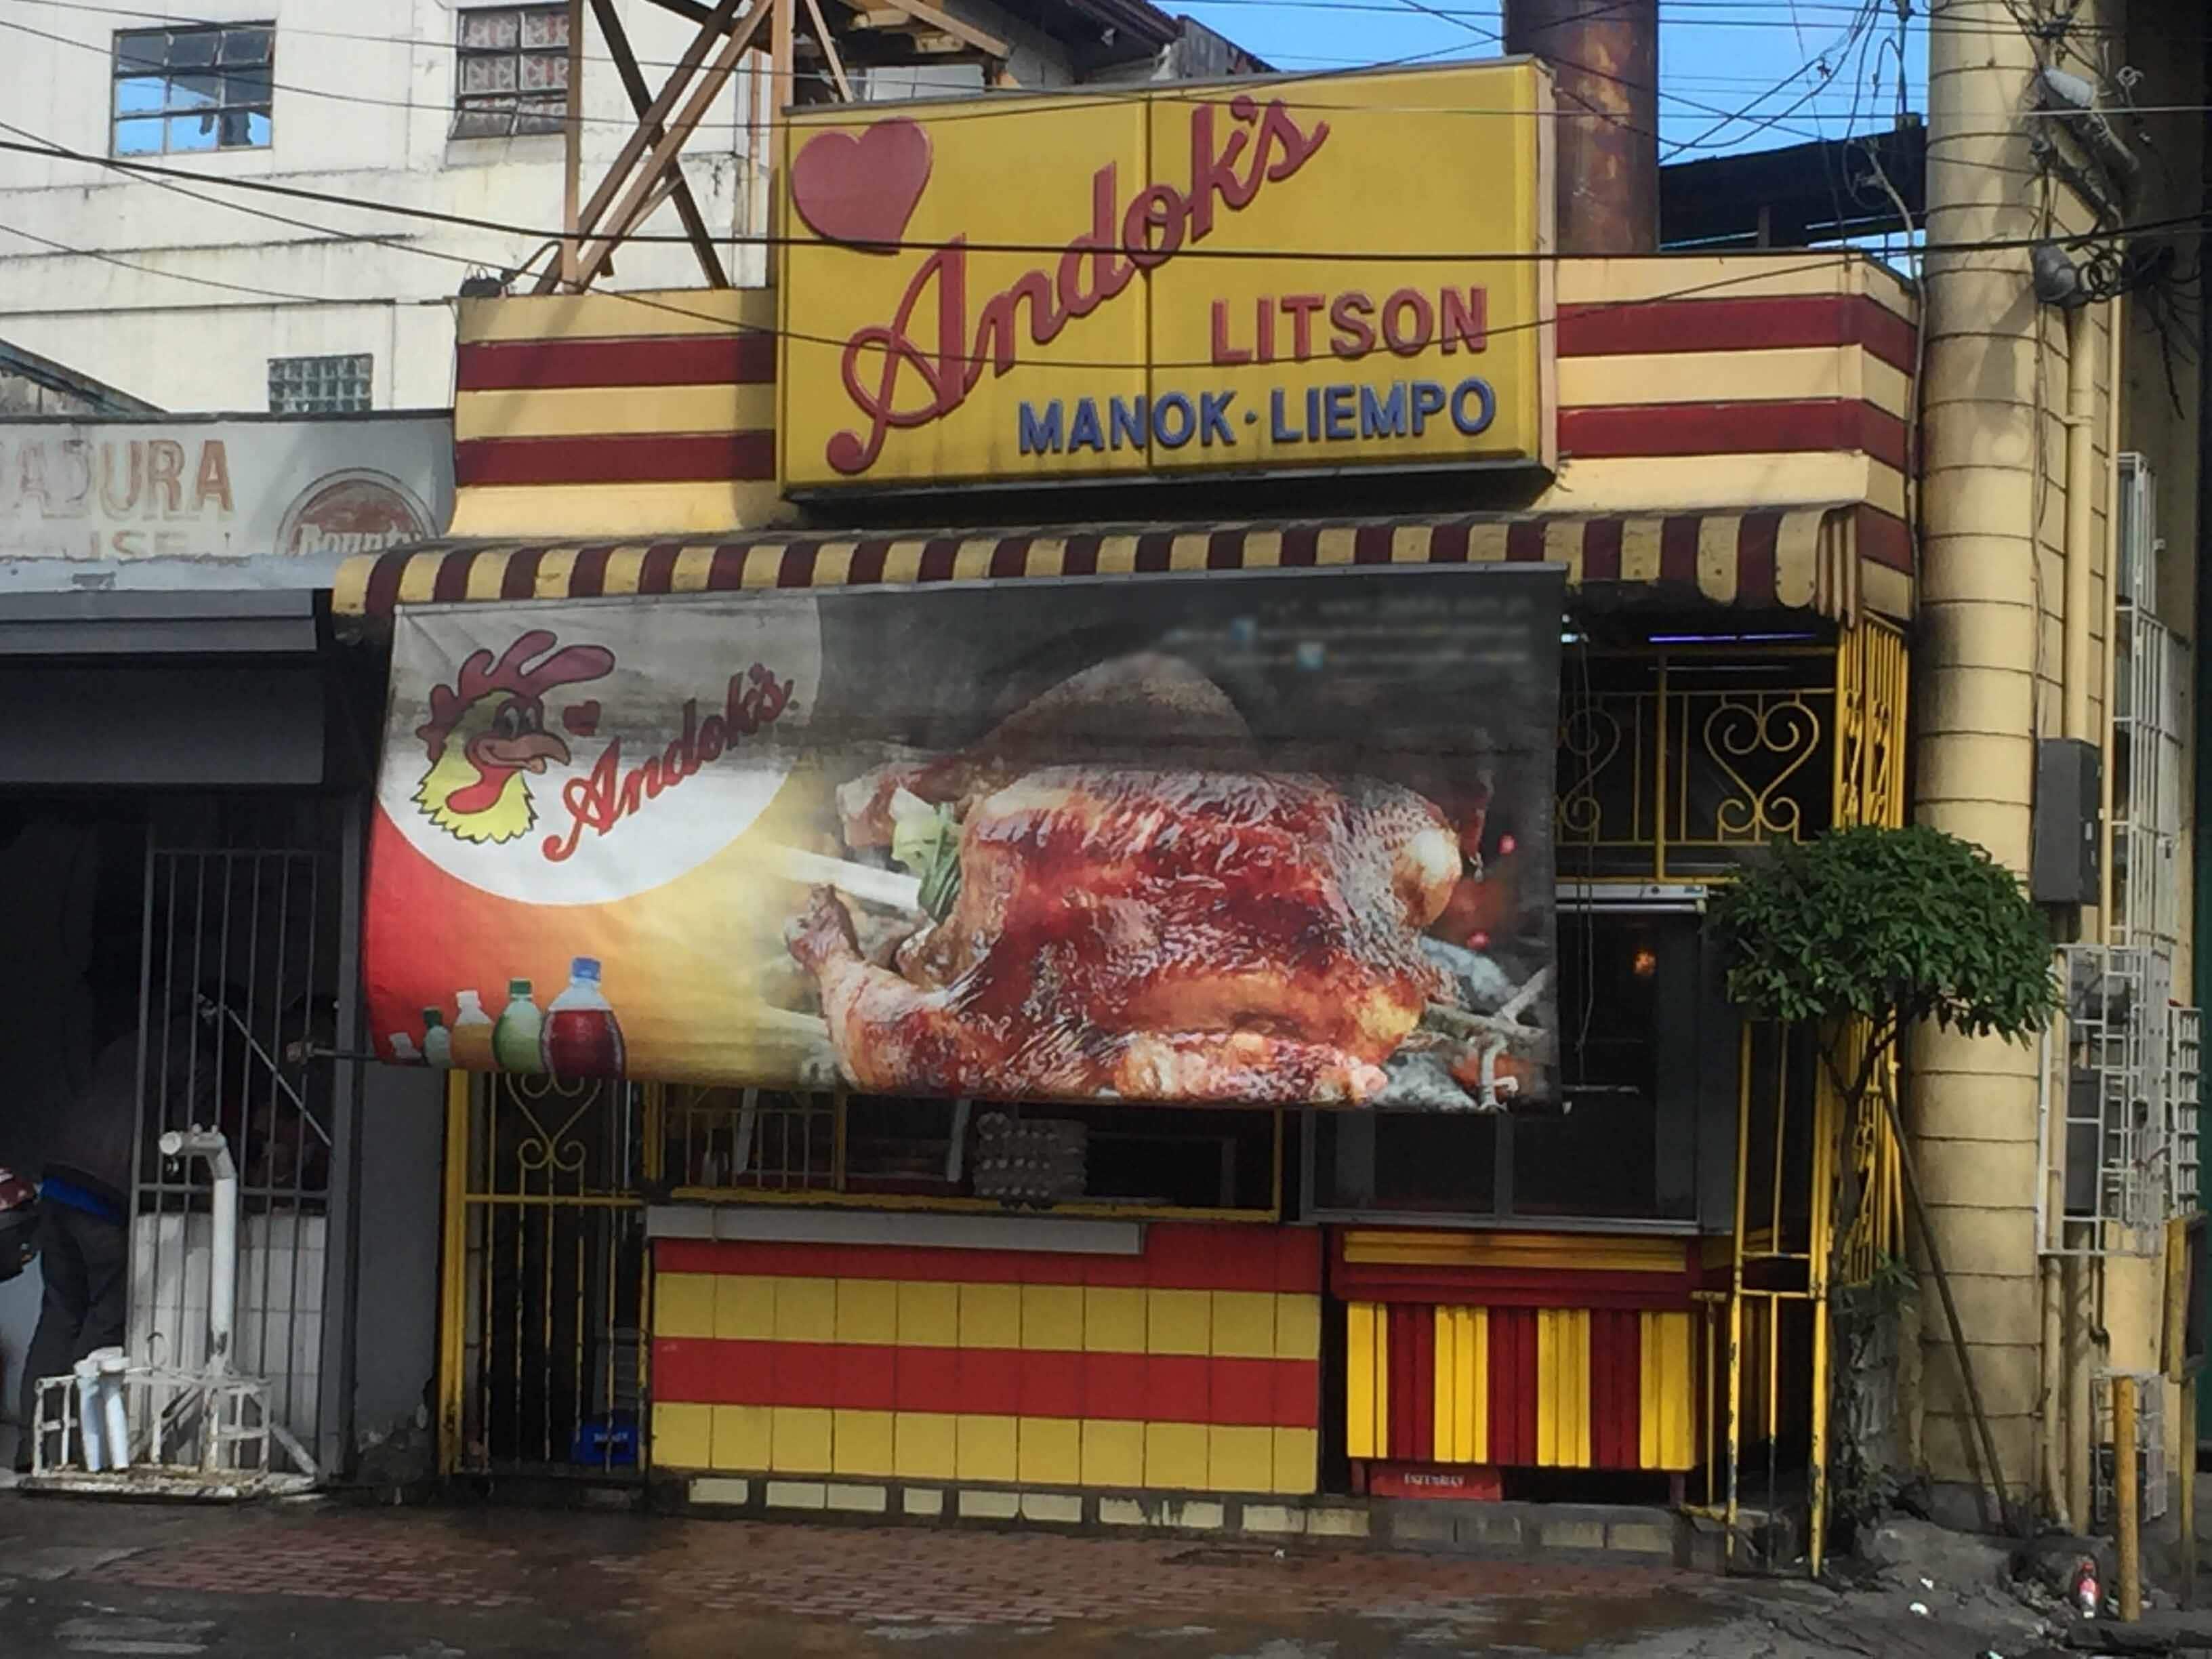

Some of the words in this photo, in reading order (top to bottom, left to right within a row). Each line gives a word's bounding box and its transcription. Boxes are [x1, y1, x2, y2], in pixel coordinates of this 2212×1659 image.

[826, 94, 1330, 475] Andok's
[1210, 283, 1488, 367] LITSON
[1018, 390, 1237, 456] MANOK
[1270, 375, 1497, 444] LIEMPO
[541, 661, 795, 863] Andok's
